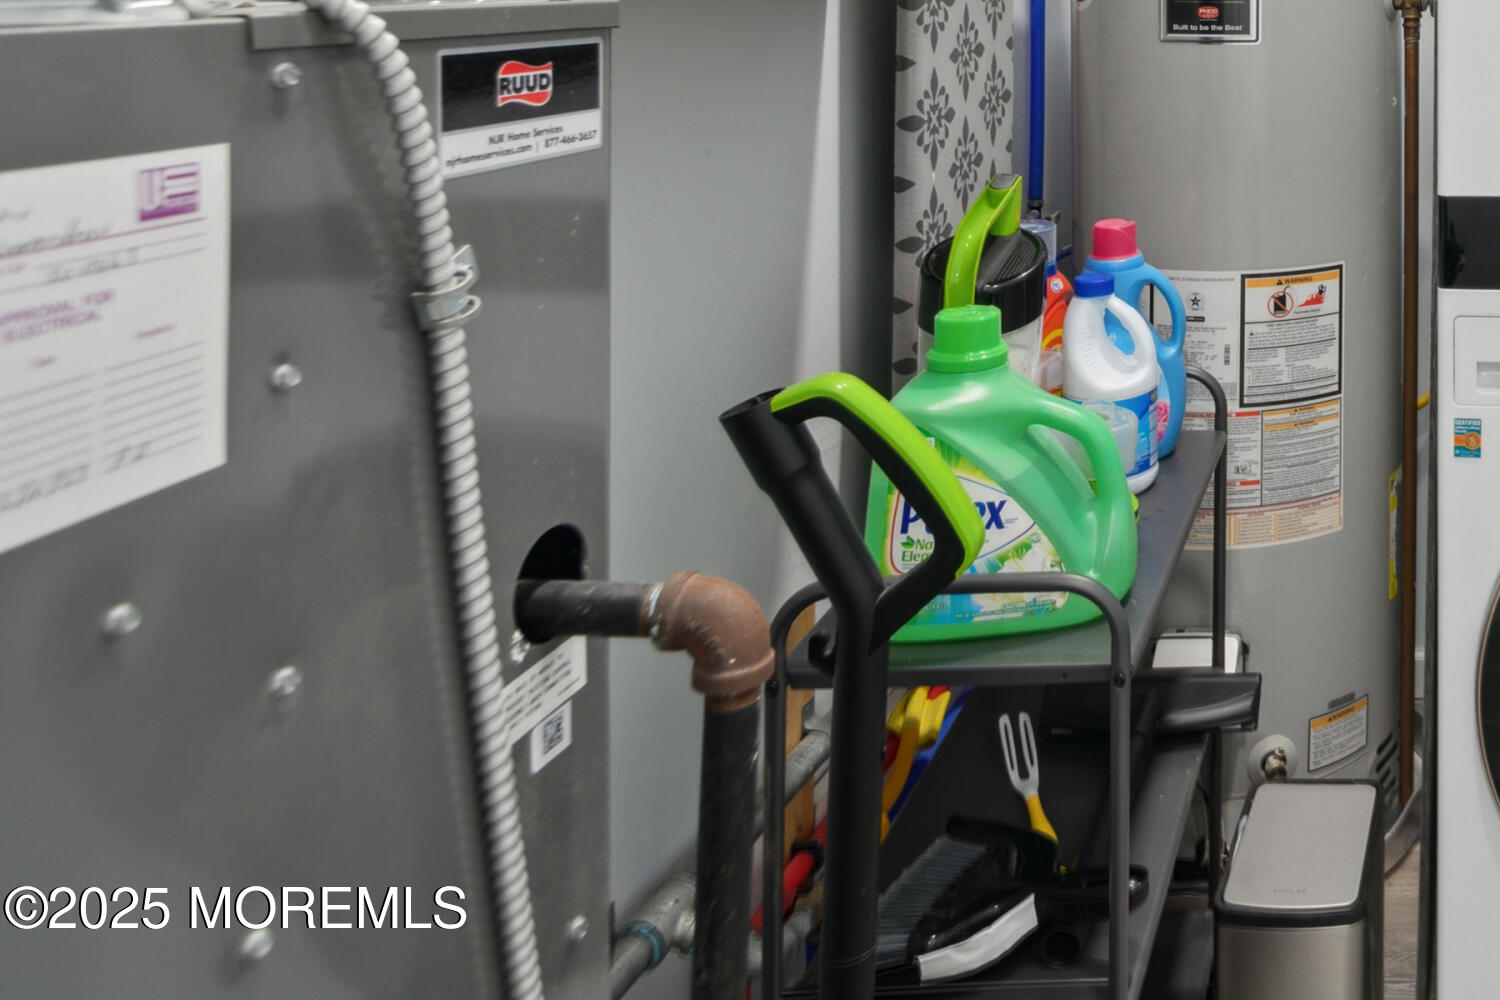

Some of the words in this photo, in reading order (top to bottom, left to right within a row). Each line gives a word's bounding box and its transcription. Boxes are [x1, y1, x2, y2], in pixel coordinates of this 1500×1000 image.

[499, 72, 552, 96] RUUD
[507, 130, 531, 142] Home
[533, 125, 564, 138] Services
